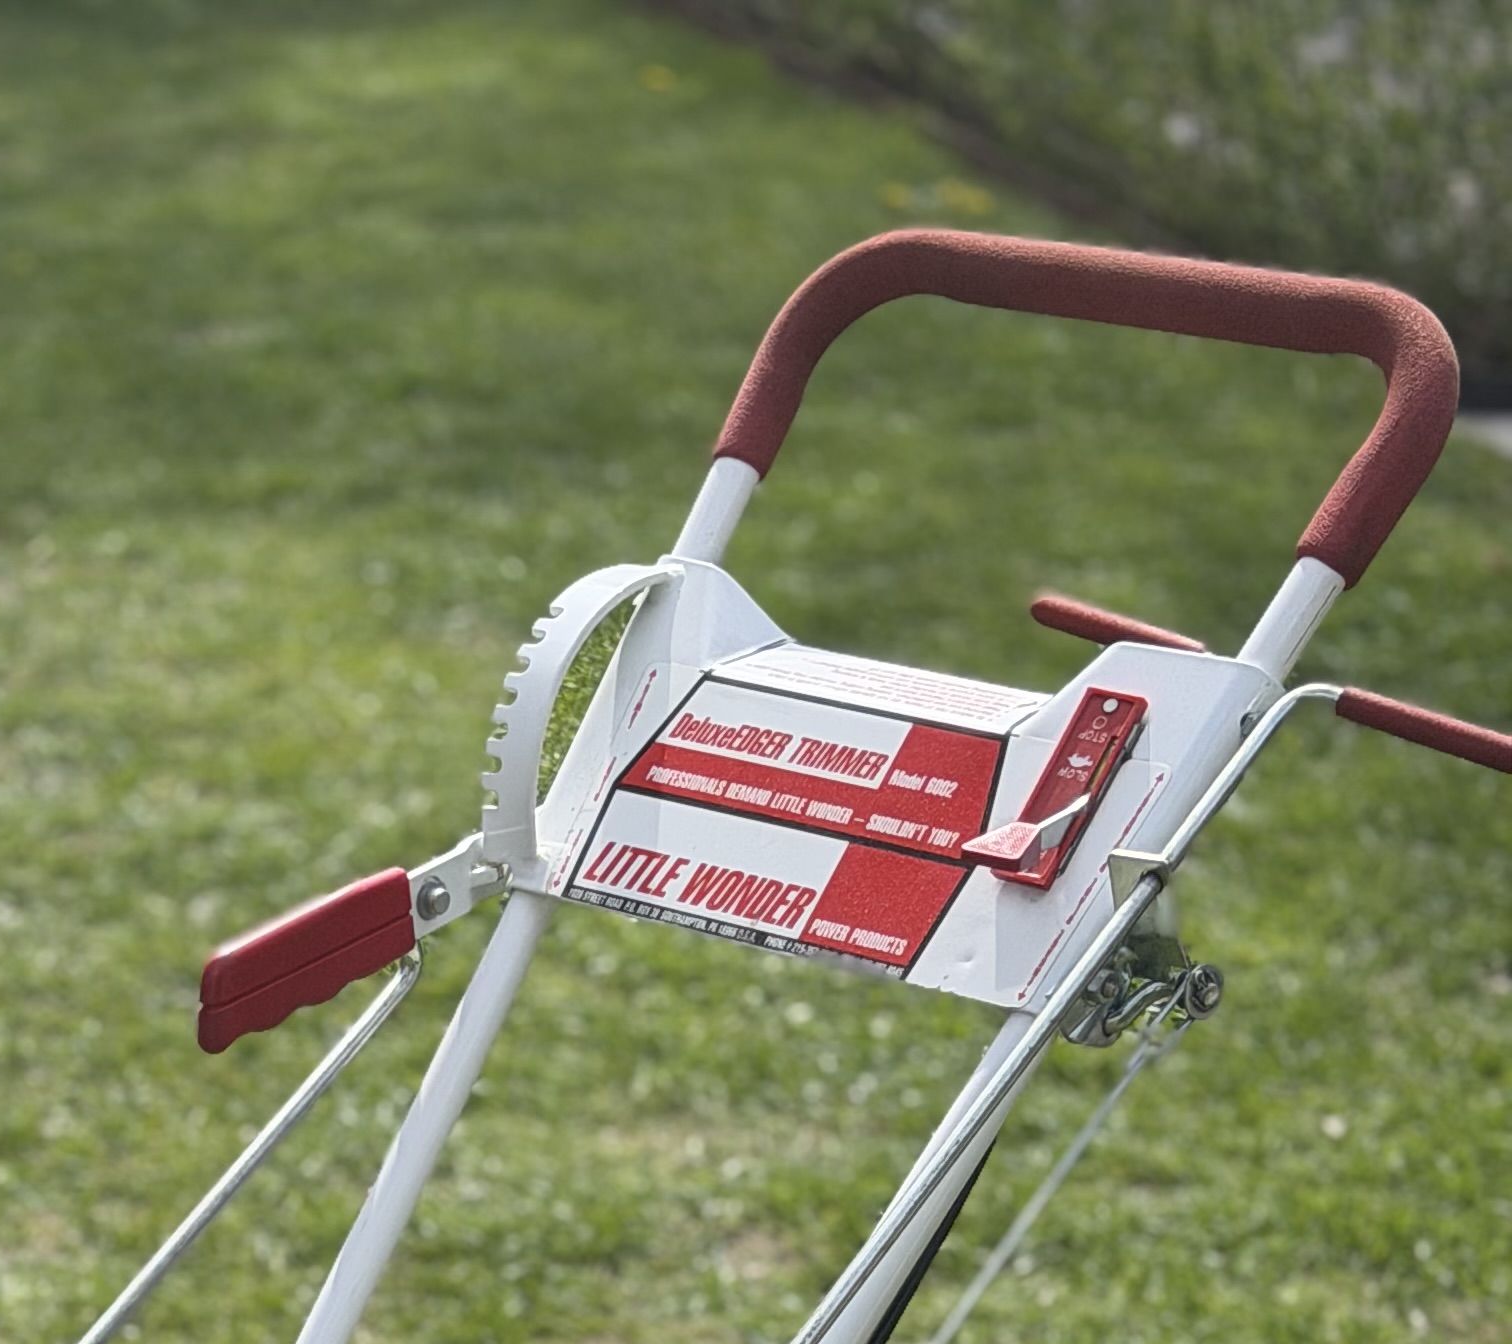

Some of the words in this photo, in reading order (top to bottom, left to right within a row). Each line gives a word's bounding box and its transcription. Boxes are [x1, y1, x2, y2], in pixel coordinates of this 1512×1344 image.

[668, 712, 794, 760] DeluxeEDGER
[787, 736, 890, 781] TRIMMER
[1077, 730, 1108, 743] STOP
[888, 769, 927, 791] Model
[924, 776, 959, 798] 6002
[1057, 766, 1089, 782] SLOW
[645, 765, 728, 796] PROFESSIONALS
[724, 782, 773, 806] DEMAND
[770, 792, 808, 815] LITTLE
[805, 799, 854, 825] WONDER
[865, 813, 930, 841] SHOULDN'T
[926, 826, 961, 848] YOU?
[583, 841, 691, 898] LITTLE
[676, 862, 818, 929] WONDER
[808, 918, 852, 942] POWER
[847, 928, 909, 956] PRODUCTS
